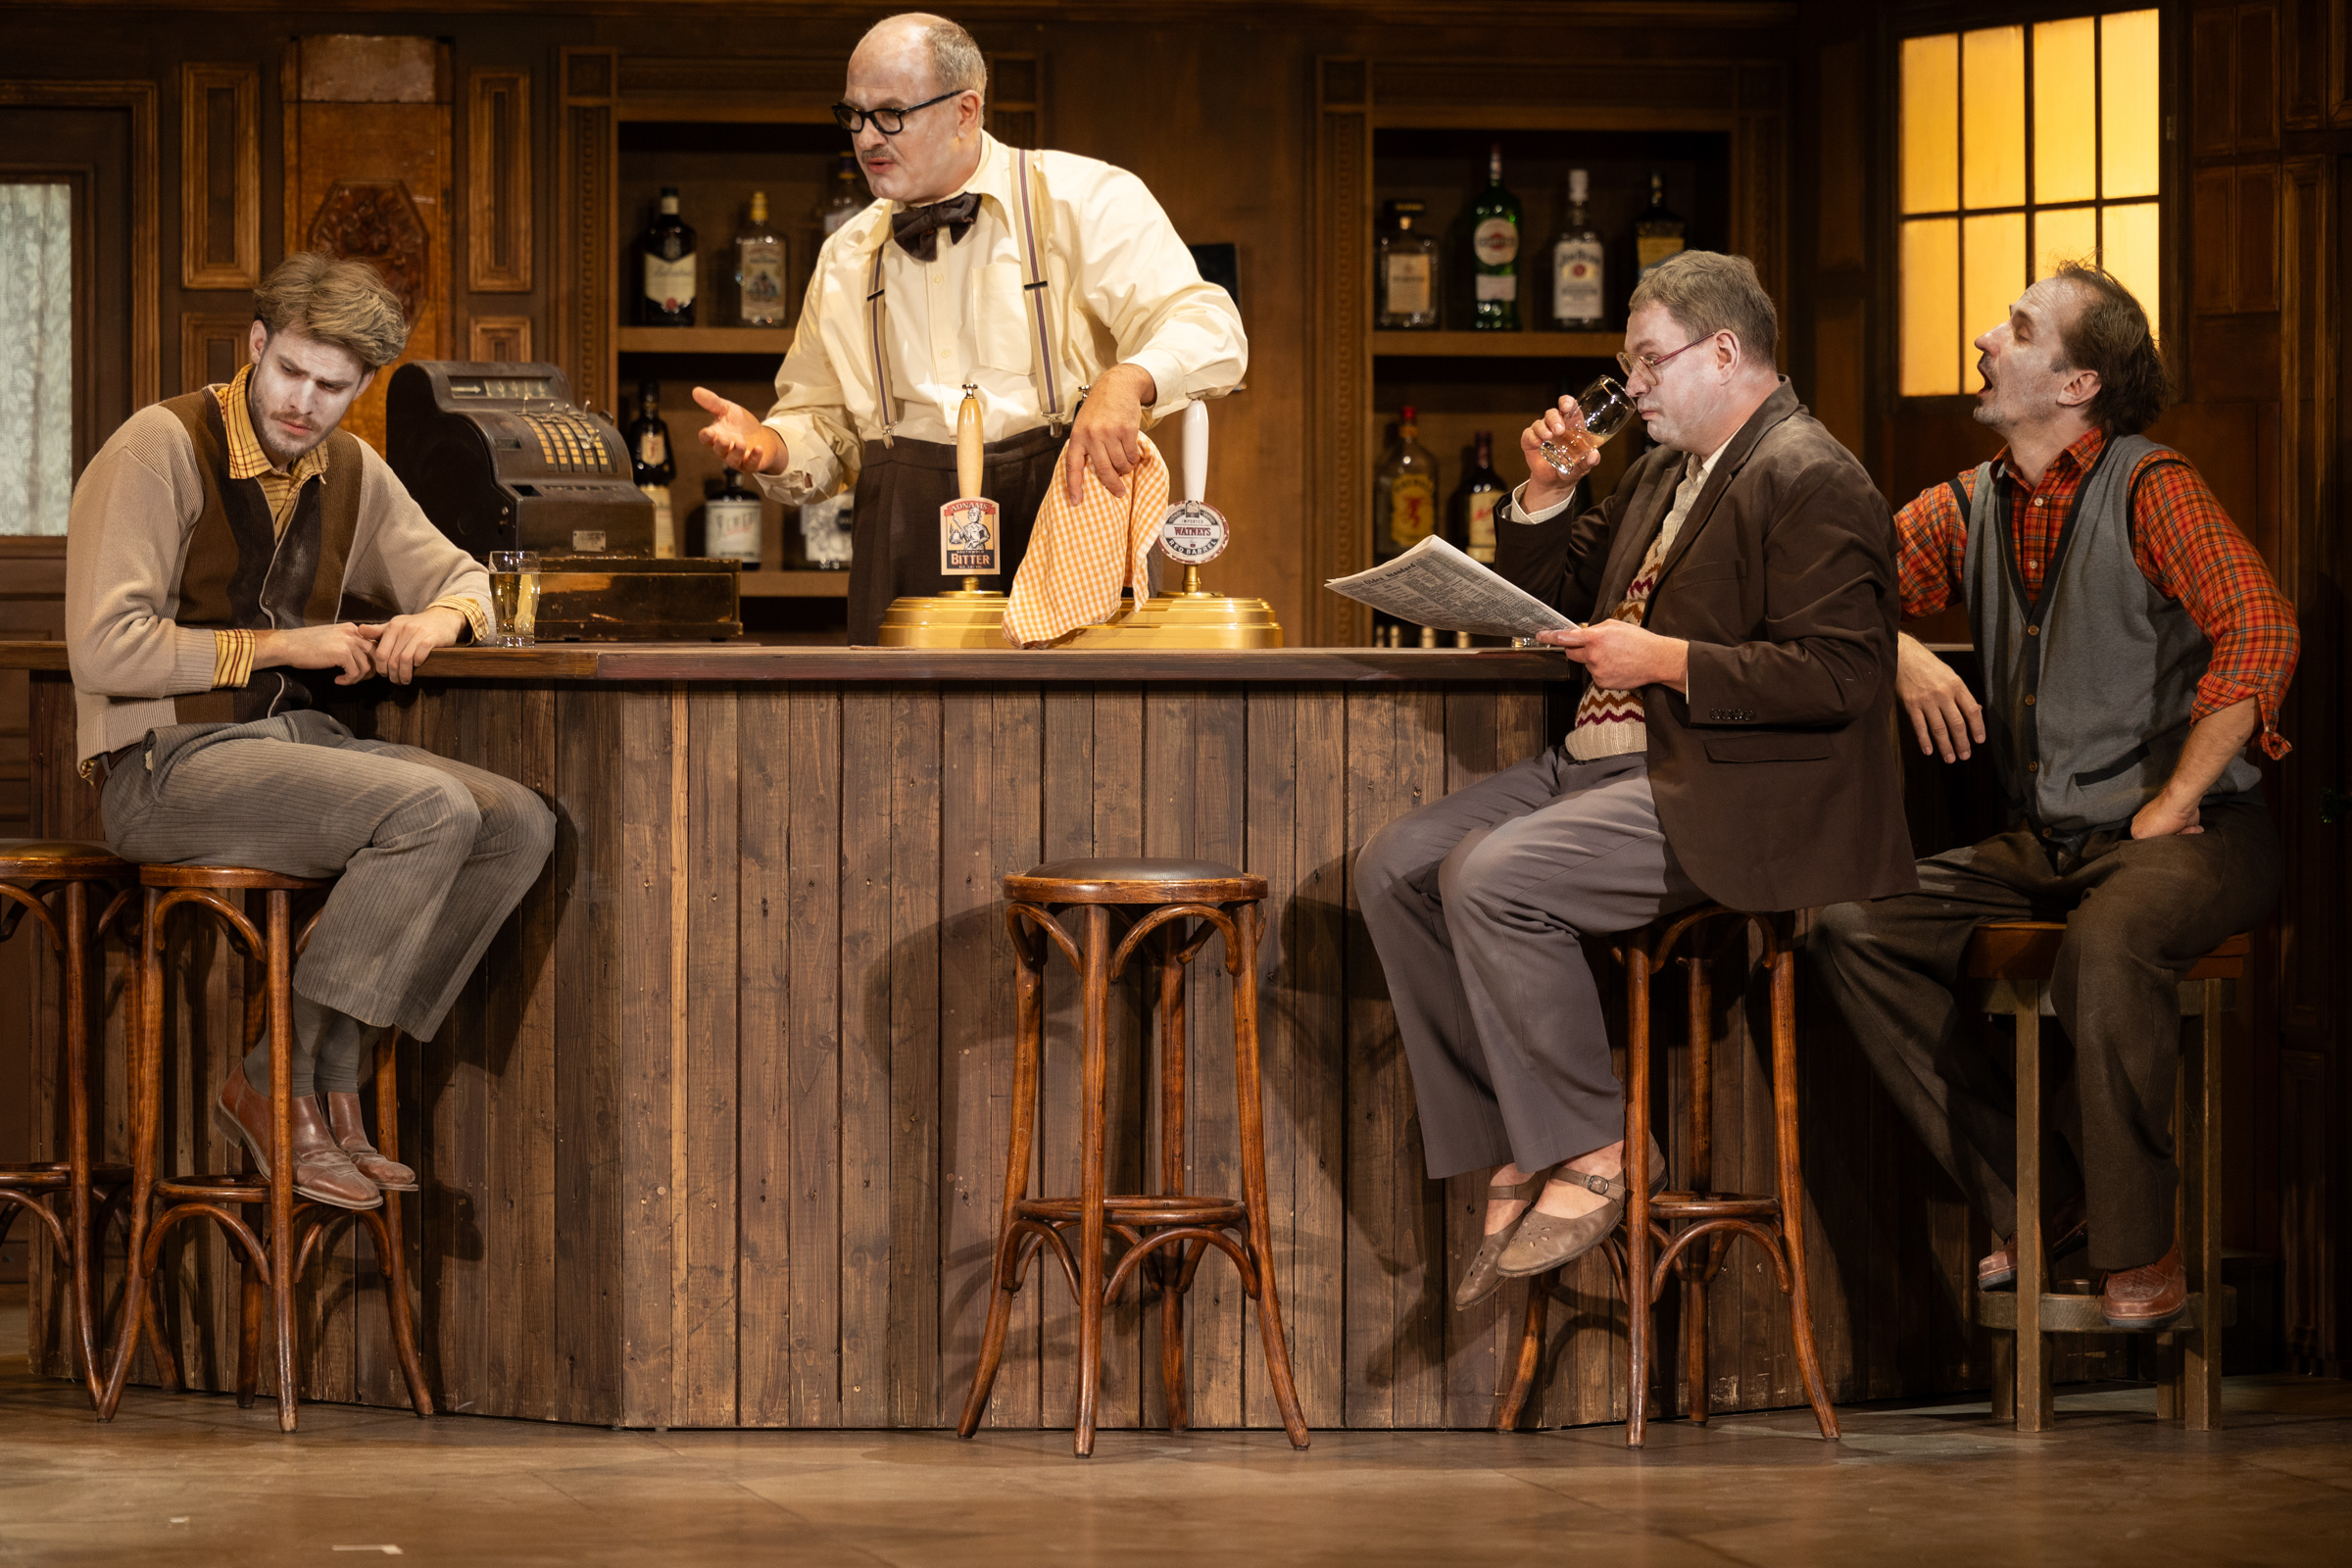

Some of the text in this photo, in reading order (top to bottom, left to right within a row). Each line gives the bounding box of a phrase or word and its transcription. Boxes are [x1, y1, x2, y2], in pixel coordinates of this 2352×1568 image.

[952, 502, 989, 512] ADNAMS
[1174, 527, 1211, 536] WATNEYS
[1169, 539, 1217, 554] RED BARREL
